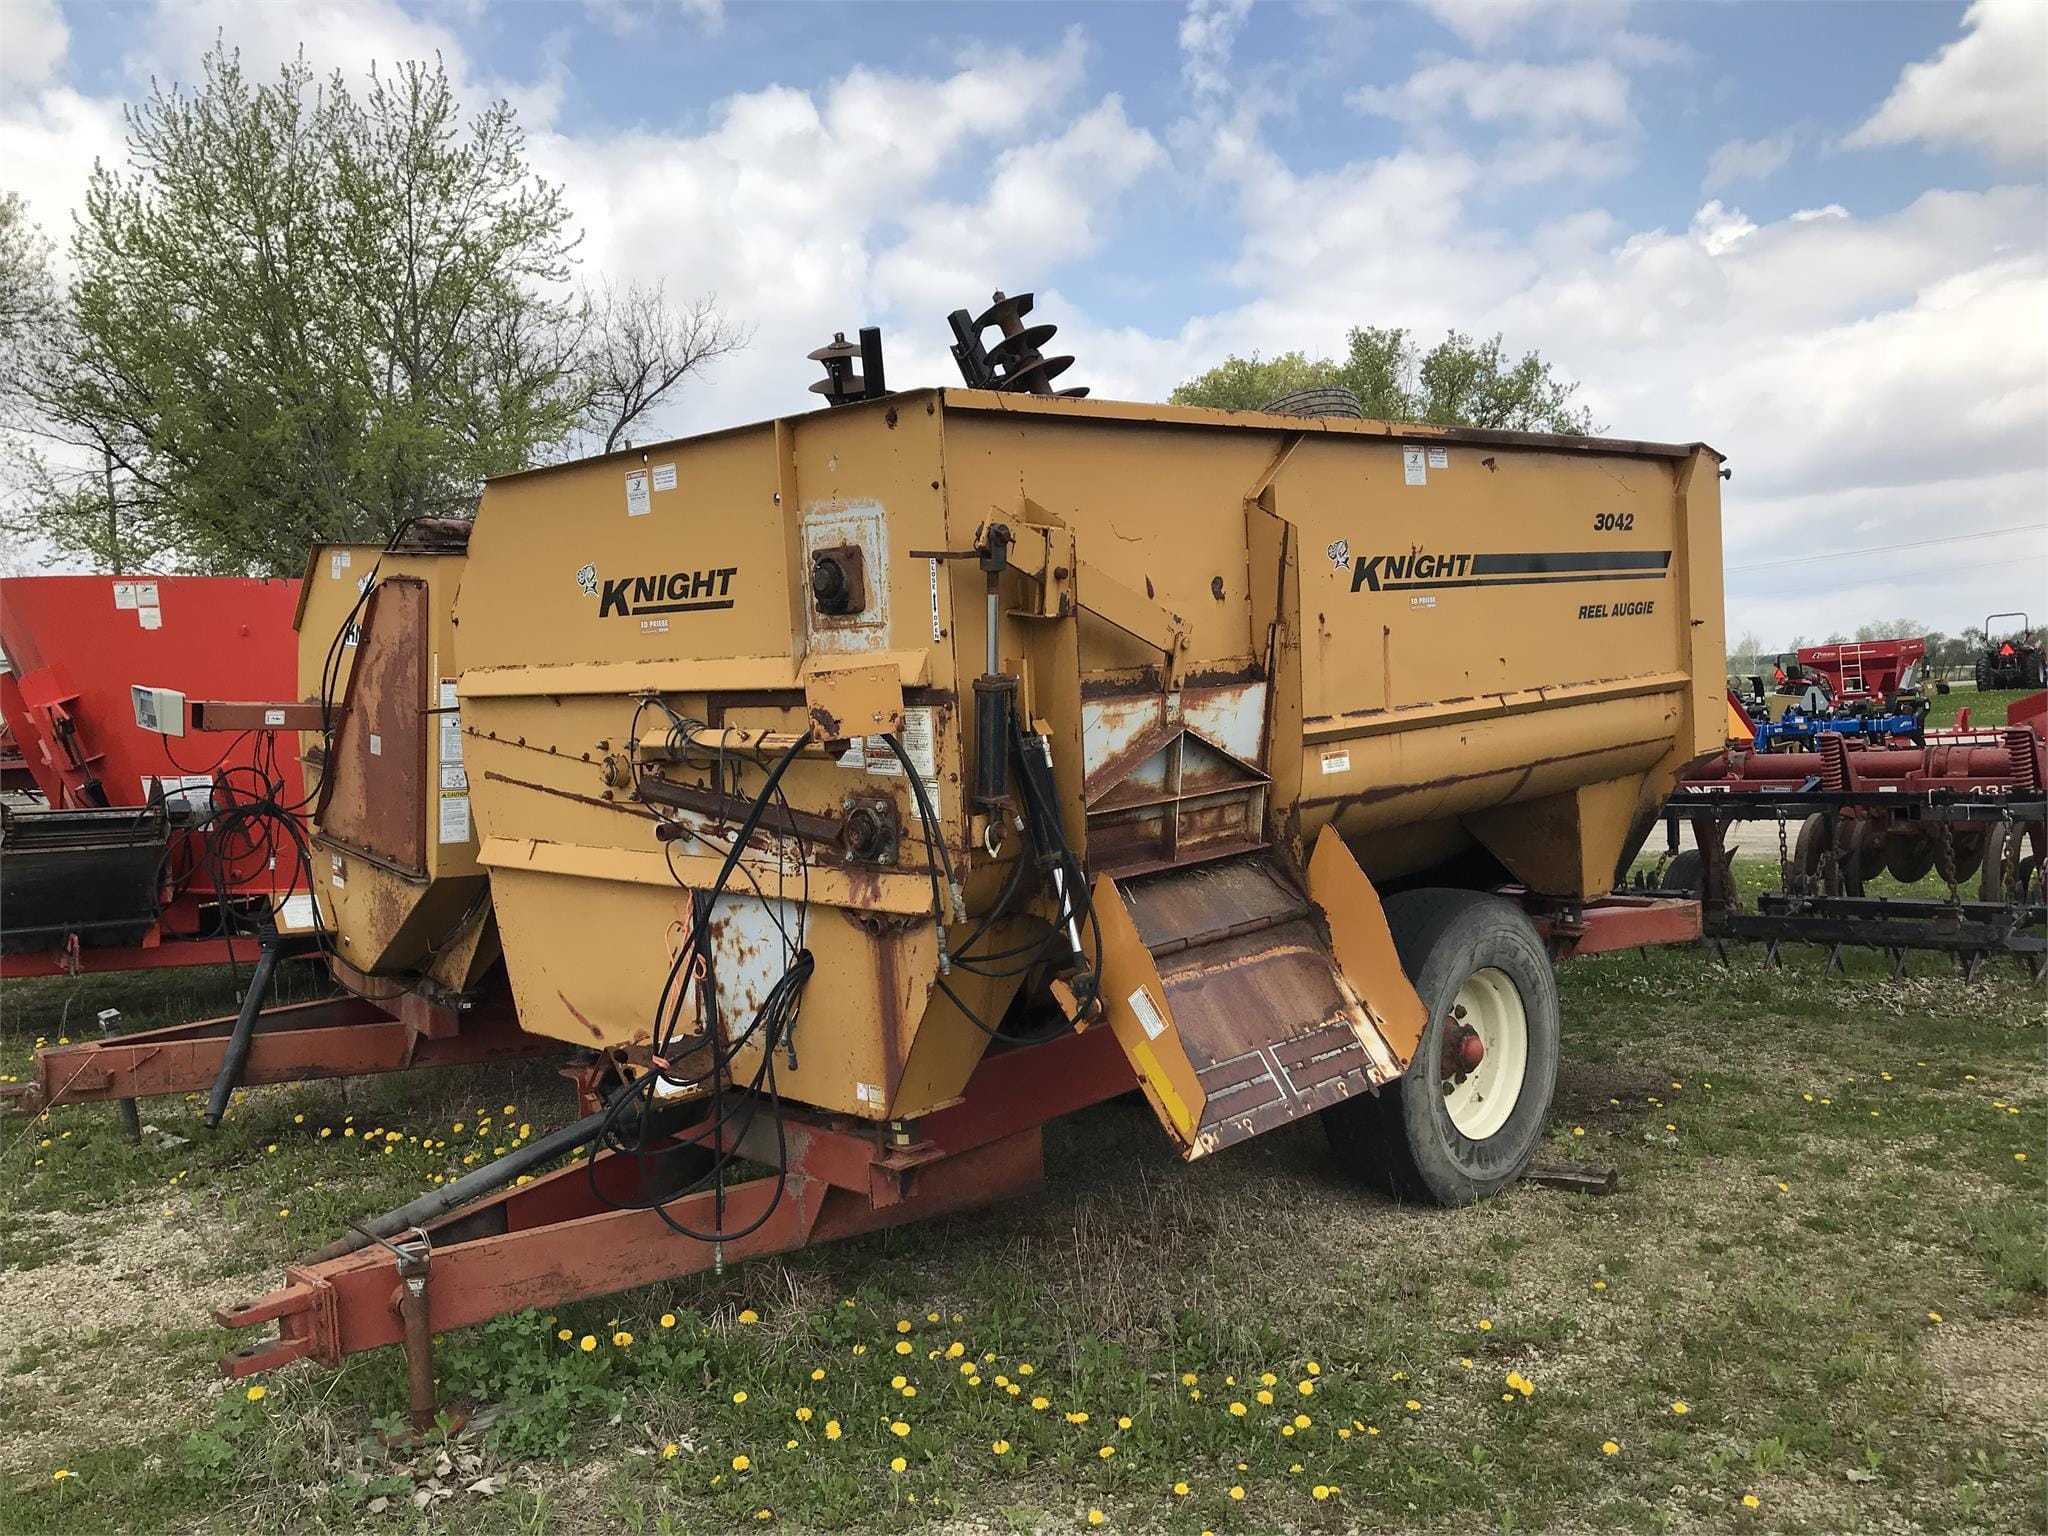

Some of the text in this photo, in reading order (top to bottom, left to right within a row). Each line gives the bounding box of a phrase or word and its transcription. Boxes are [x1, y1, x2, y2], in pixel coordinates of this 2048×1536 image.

[1593, 513, 1634, 531] 3042
[1350, 554, 1472, 592] KNIGHT
[599, 567, 738, 618] KNIGHT
[1578, 601, 1655, 620] REEL AUGGIE
[640, 621, 649, 629] ED
